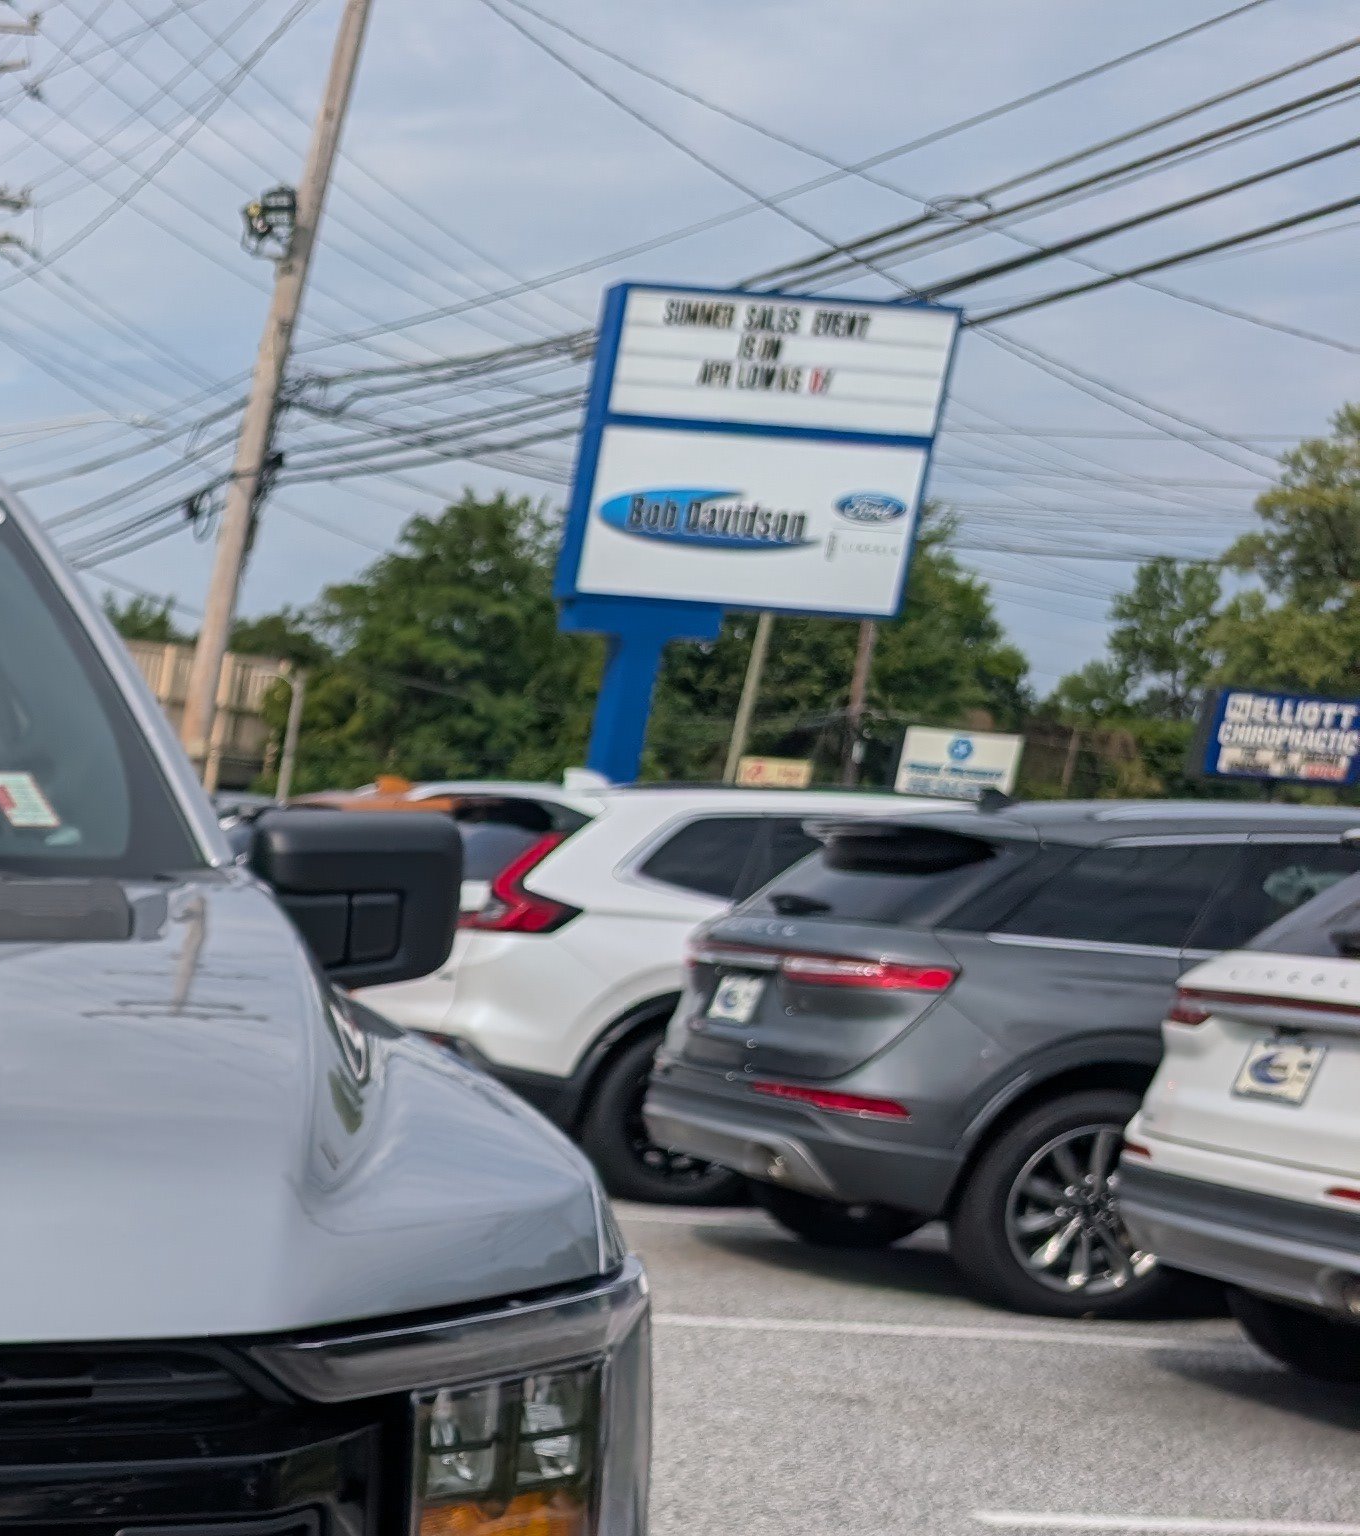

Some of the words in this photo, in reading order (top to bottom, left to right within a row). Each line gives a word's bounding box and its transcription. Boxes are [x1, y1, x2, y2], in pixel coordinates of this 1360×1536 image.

[663, 299, 735, 328] SUMMER
[743, 304, 802, 334] SALES
[811, 308, 871, 338] EVENT
[737, 333, 756, 361] IS
[626, 495, 679, 534] Bob
[683, 499, 808, 544] Davidson
[1250, 696, 1359, 731] ELLIOTT
